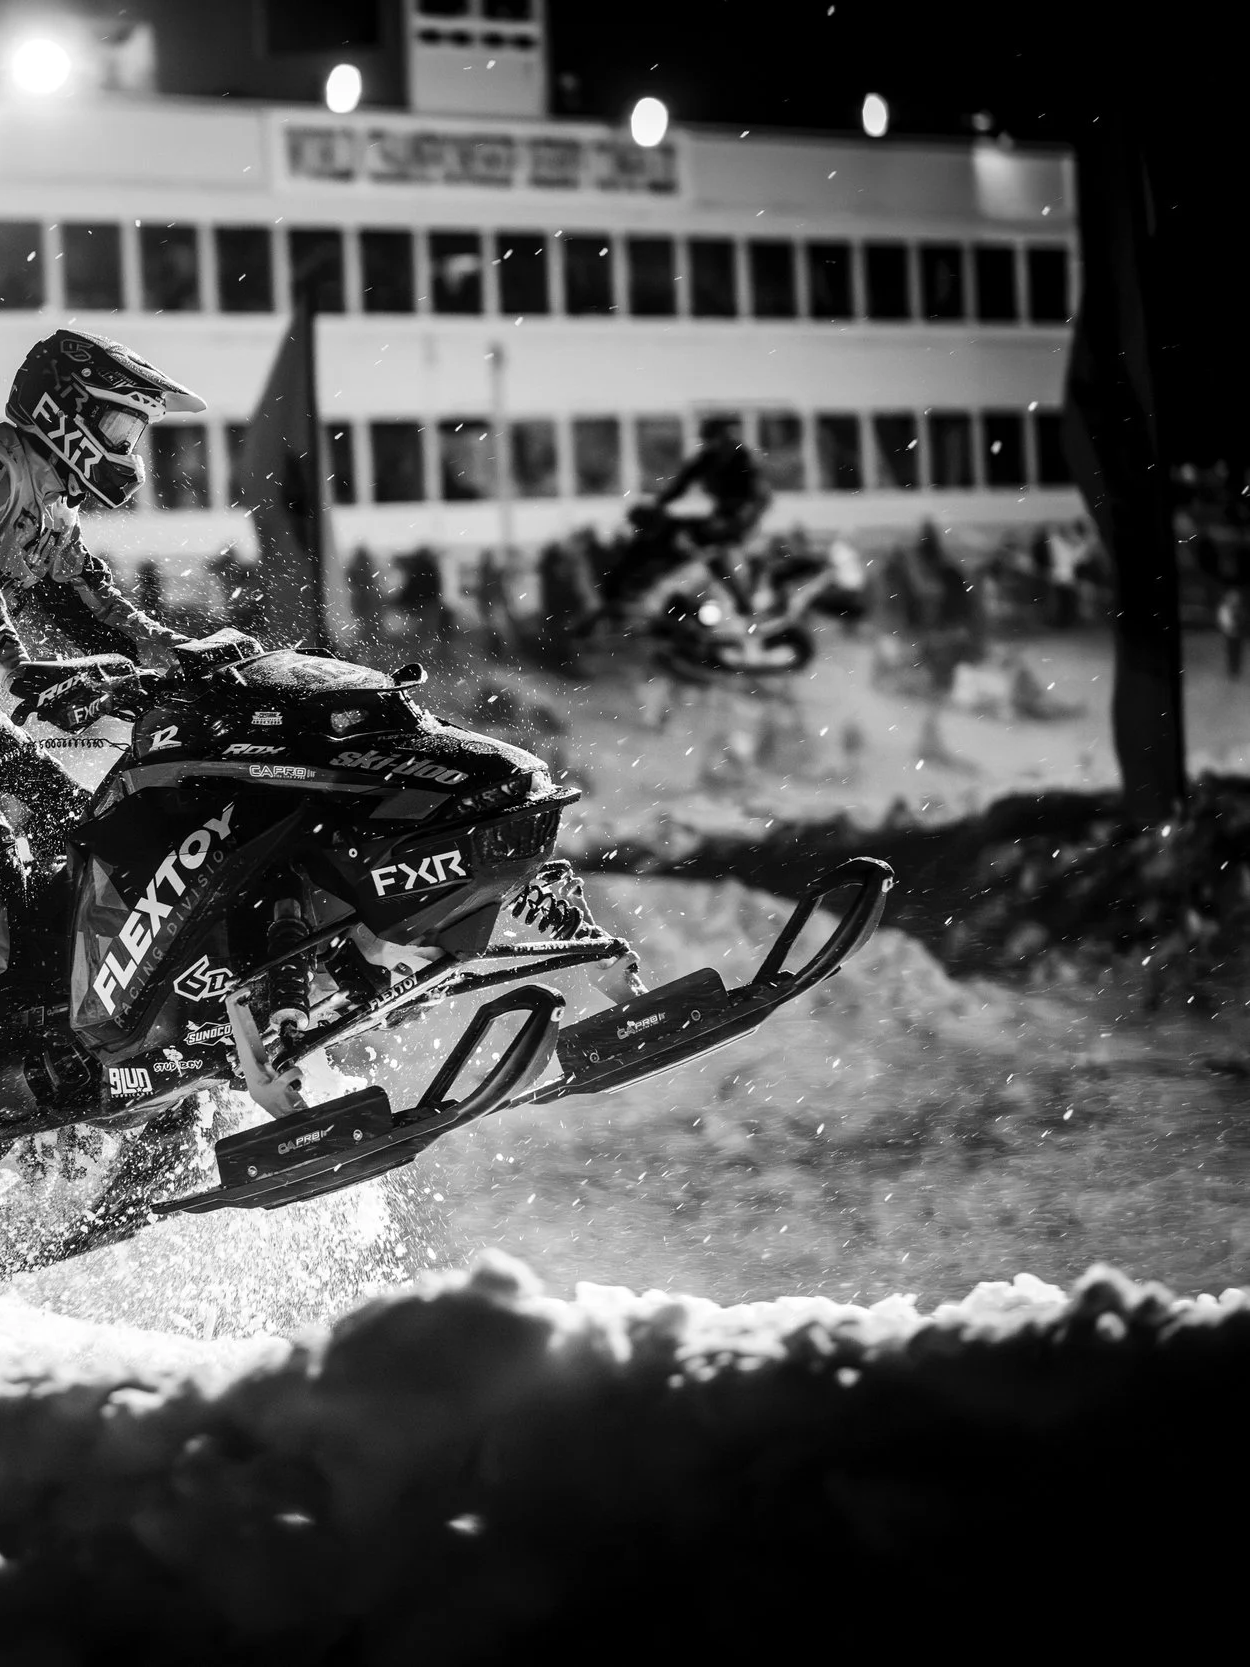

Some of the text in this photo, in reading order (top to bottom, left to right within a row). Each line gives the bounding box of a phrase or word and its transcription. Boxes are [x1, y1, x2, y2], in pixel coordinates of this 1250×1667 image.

[31, 391, 103, 480] FXR
[222, 743, 287, 756] ROX
[370, 849, 467, 897] FXR
[93, 800, 235, 1016] FLEXTOY
[368, 974, 419, 1011] FLEXTOY
[188, 1023, 231, 1044] SUNOCO
[108, 1067, 153, 1095] BLUD
